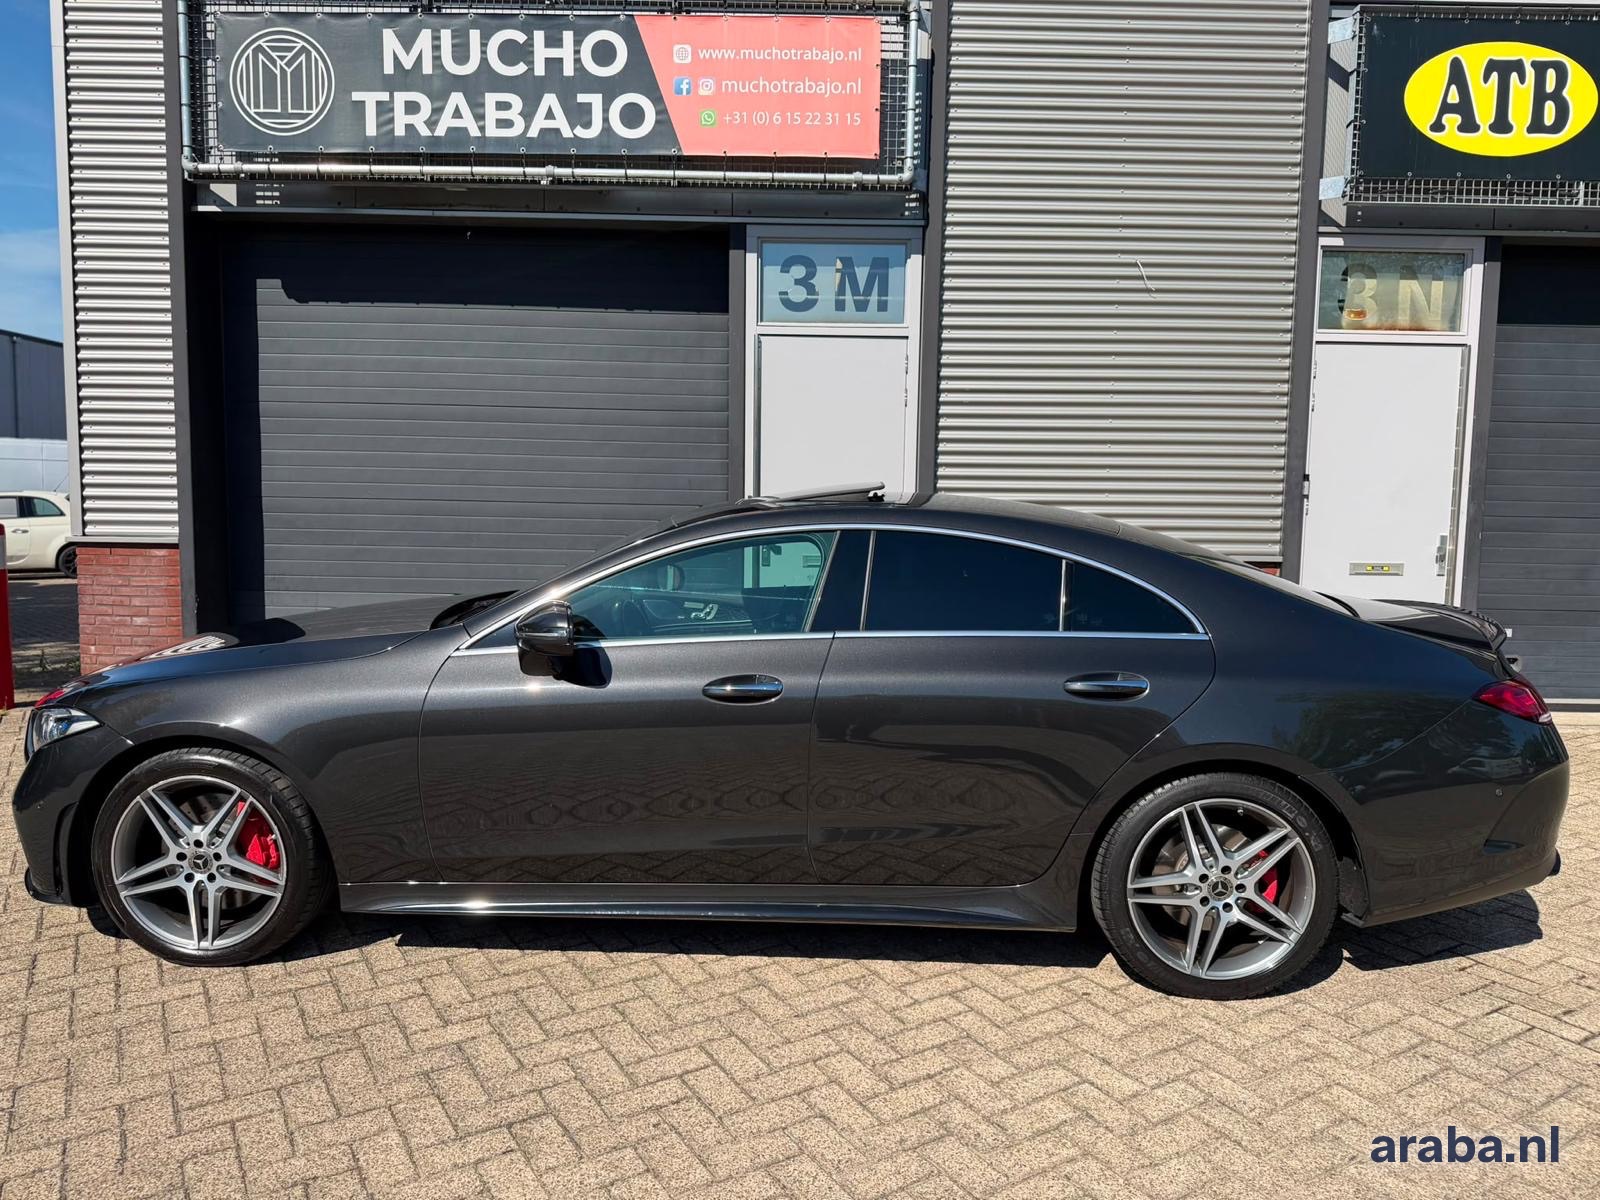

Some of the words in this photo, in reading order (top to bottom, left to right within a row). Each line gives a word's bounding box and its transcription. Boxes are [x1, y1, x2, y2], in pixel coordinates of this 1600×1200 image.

[382, 28, 628, 77] MUCHO
[698, 46, 862, 64] www.muchotrabajo.nl
[721, 76, 862, 97] muchotrabajo.nl
[1428, 55, 1572, 136] ATB
[351, 91, 656, 139] TRABAJO
[723, 111, 748, 124] +31
[752, 111, 769, 126] (0)
[773, 112, 782, 125] 6
[786, 112, 801, 125] 15
[805, 112, 821, 125] 22
[825, 112, 840, 125] 31
[846, 112, 861, 125] 15
[778, 254, 819, 313] 3
[834, 256, 889, 313] M
[1398, 264, 1443, 321] N
